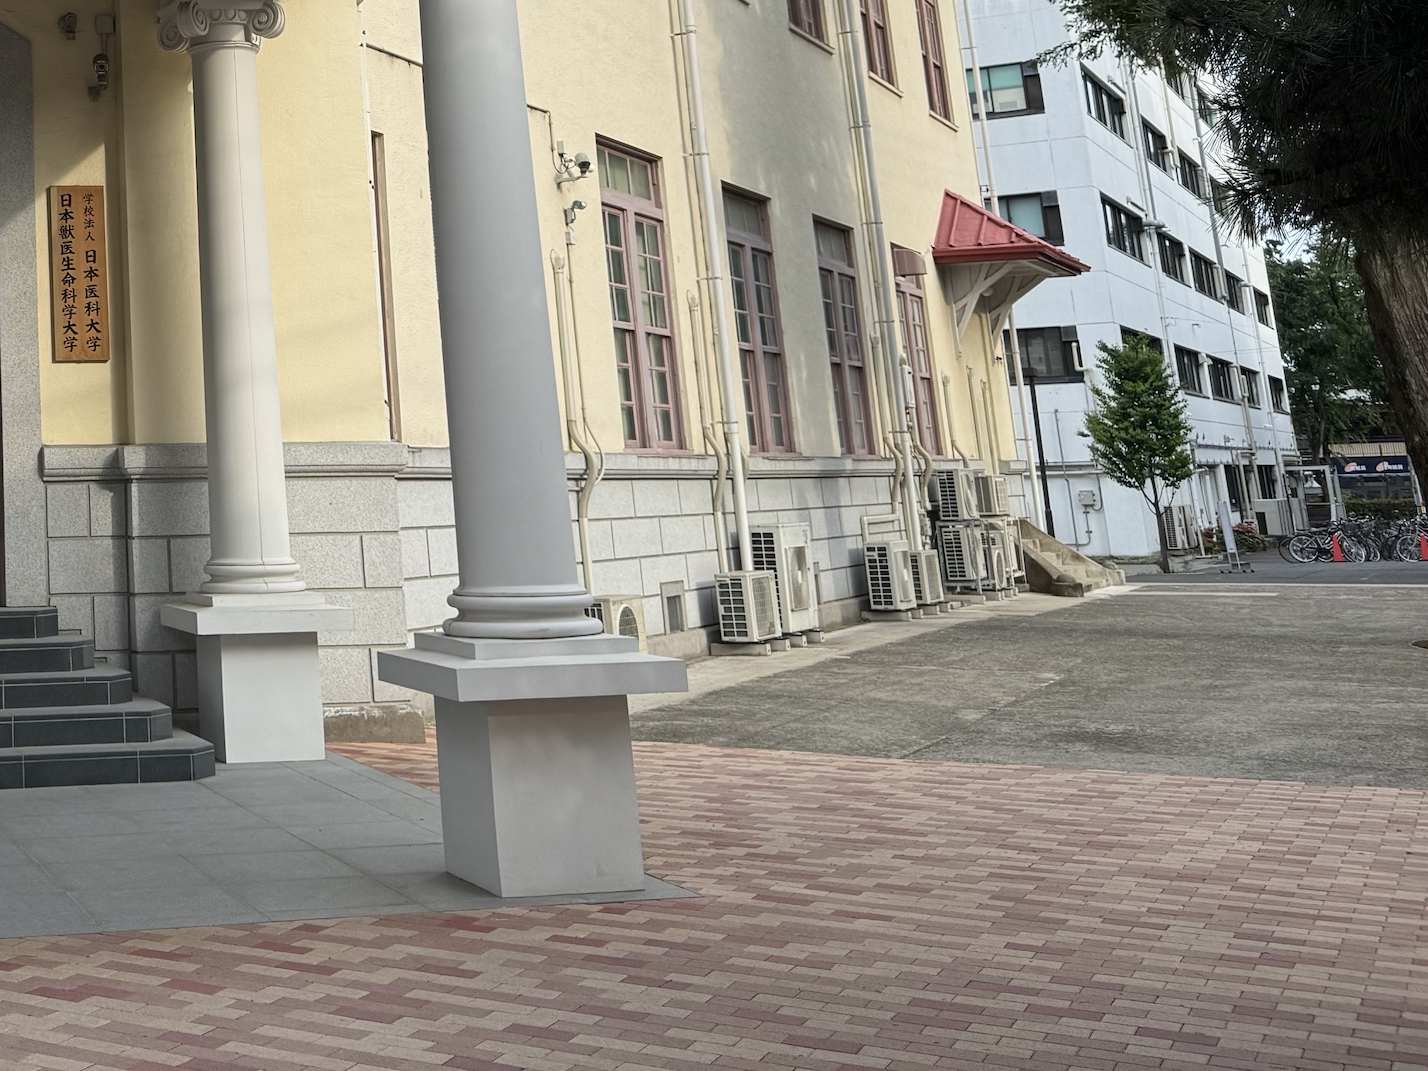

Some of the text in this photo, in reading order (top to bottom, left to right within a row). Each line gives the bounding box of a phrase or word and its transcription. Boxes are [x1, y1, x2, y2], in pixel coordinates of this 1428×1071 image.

[58, 193, 79, 353] 日本獣医生命科学大学
[83, 193, 102, 352] 学校法人 日本医科大学
